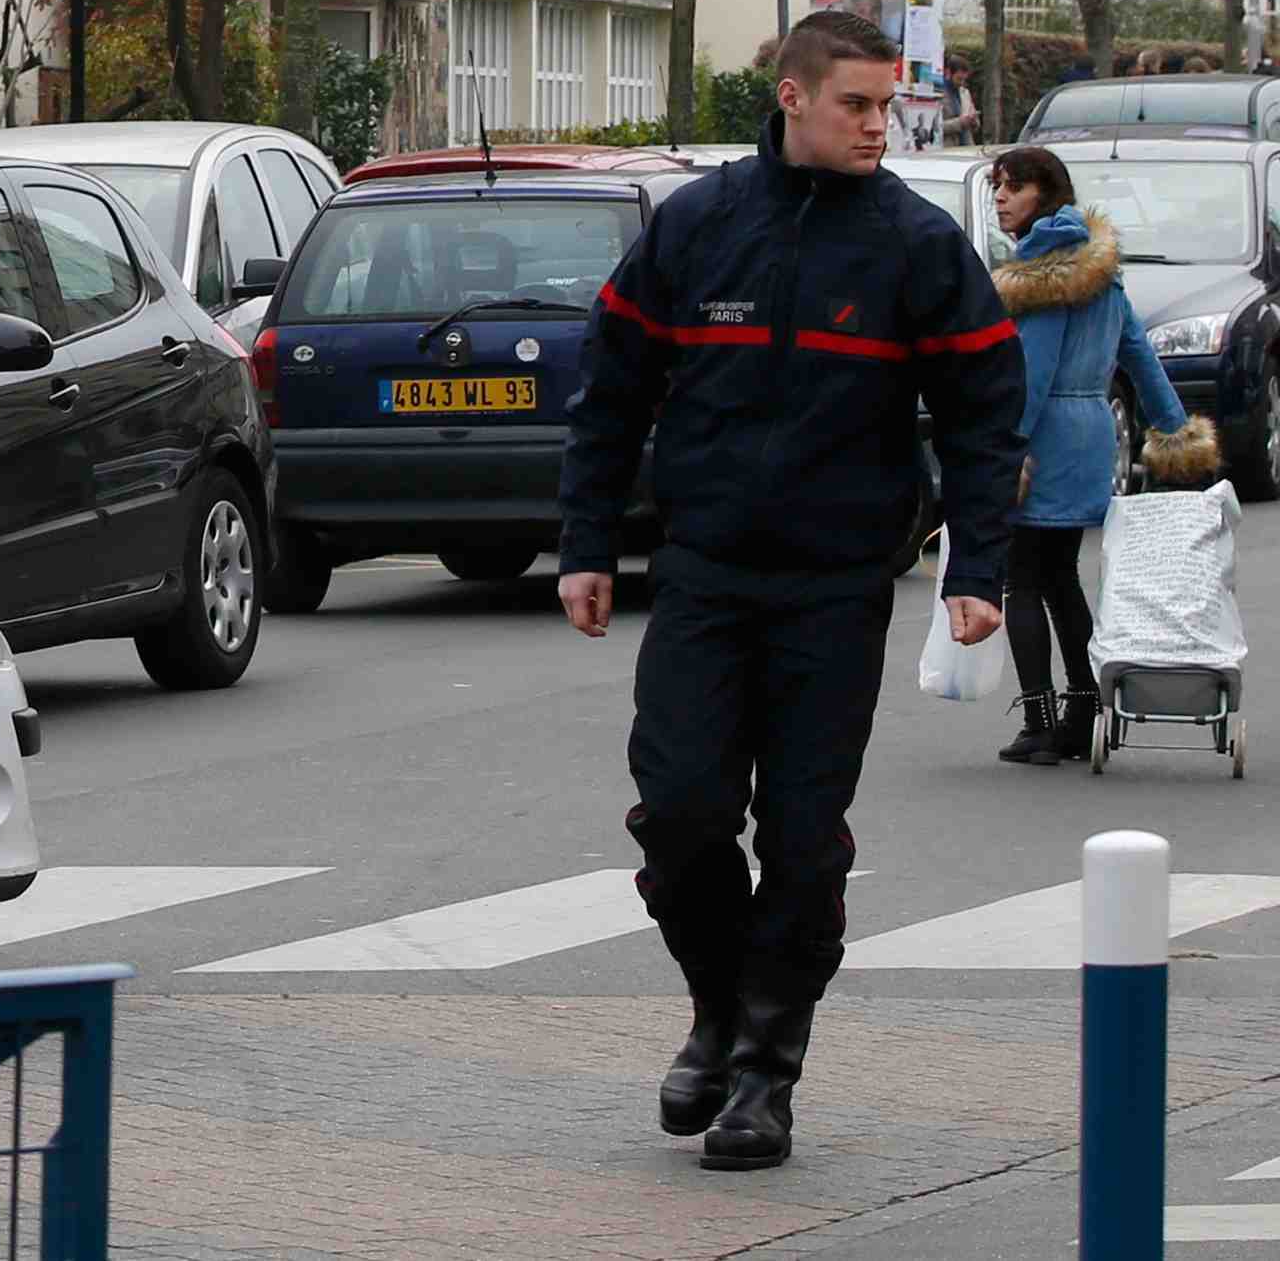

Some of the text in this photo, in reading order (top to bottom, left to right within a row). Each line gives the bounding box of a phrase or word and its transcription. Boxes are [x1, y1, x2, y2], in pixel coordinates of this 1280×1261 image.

[709, 311, 744, 322] PARIS
[395, 380, 534, 407] 4843 WL 93
